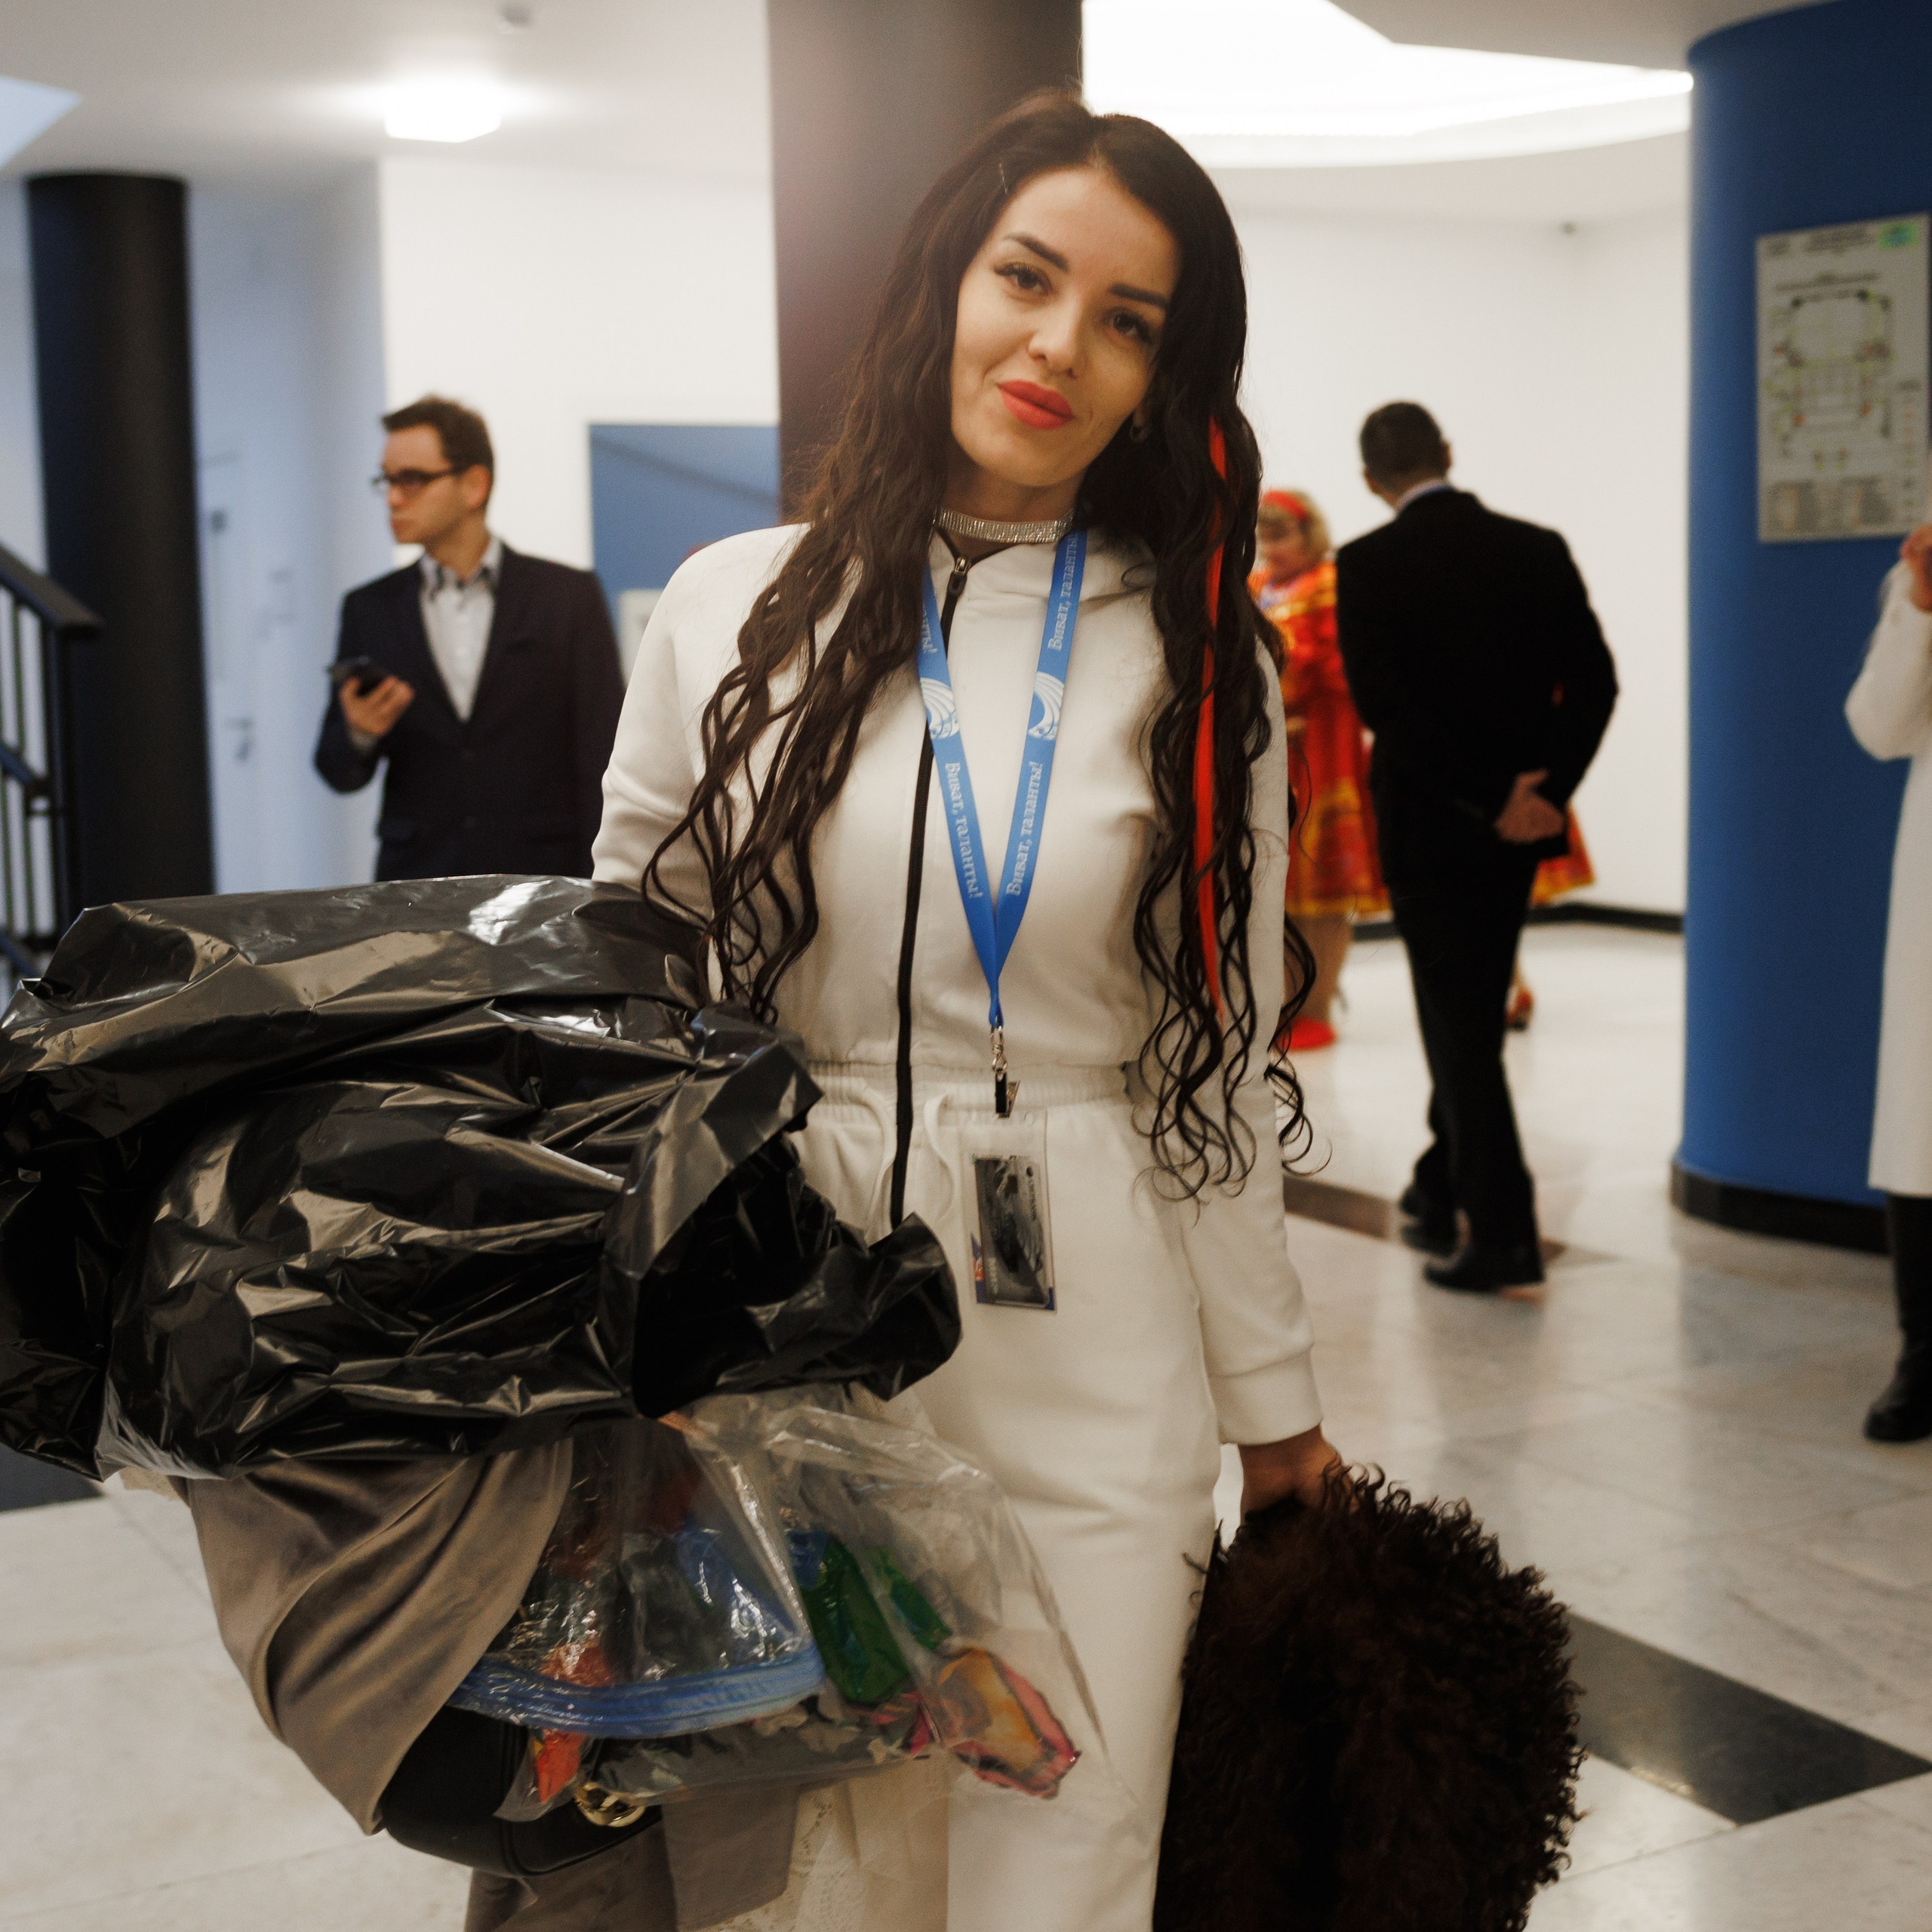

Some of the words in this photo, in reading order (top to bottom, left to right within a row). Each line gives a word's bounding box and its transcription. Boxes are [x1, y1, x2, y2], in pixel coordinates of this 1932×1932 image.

[1048, 601, 1072, 651] Виват,
[946, 762, 964, 815] Виват,
[955, 815, 983, 899] таланты!
[1006, 838, 1033, 897] Виват,
[1020, 761, 1044, 836] таланты!
